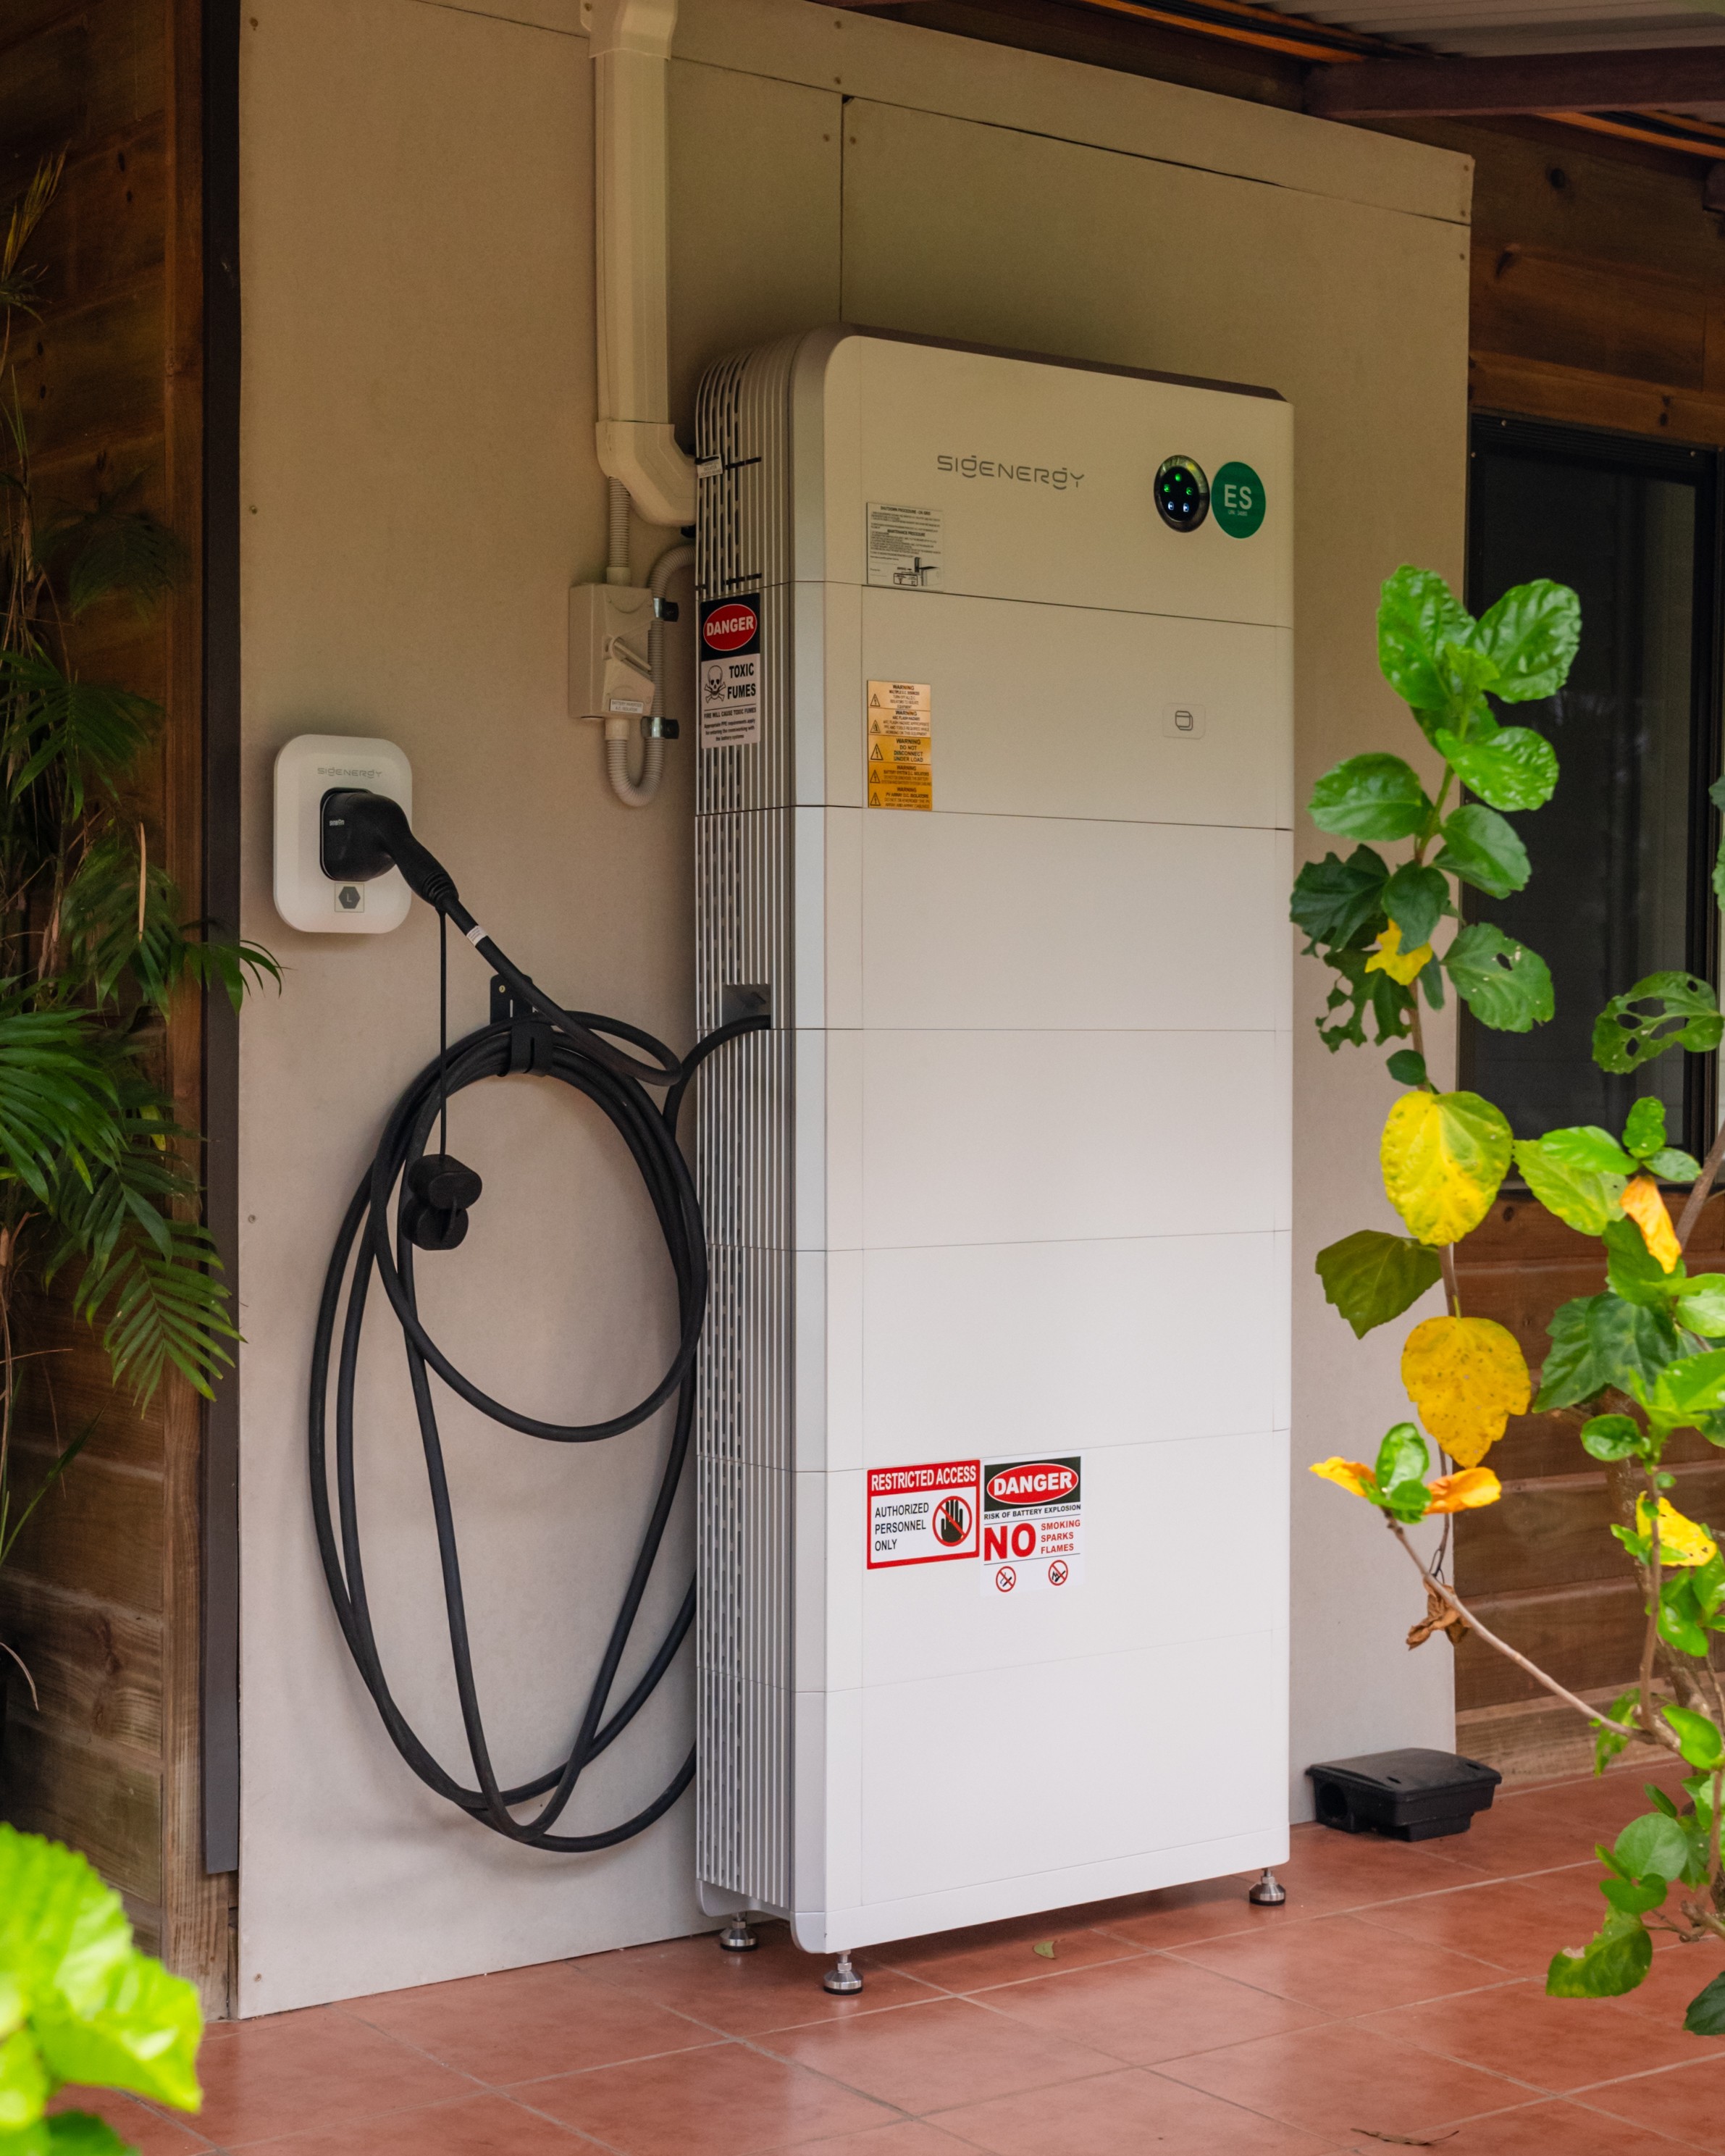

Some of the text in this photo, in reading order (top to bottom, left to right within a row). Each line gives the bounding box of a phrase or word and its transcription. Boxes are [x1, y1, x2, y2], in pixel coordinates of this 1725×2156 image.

[937, 455, 1085, 490] SIGENERGY
[1224, 484, 1252, 510] ES
[706, 616, 754, 637] DANGER
[729, 663, 755, 679] TOXIC
[727, 683, 756, 700] FUMES
[316, 767, 383, 779] SIGENERGY
[346, 894, 352, 902] L
[871, 1465, 976, 1491] RESTRICTED ACCESS
[994, 1472, 1073, 1497] DANGER
[875, 1502, 929, 1519] AUTHORIZED
[1012, 1508, 1042, 1518] BATTERY
[1044, 1504, 1081, 1514] EXPLOSION
[875, 1519, 926, 1535] PERSONNEL
[1041, 1519, 1081, 1531] SMOKING
[875, 1539, 897, 1552] ONLY
[983, 1522, 1036, 1561] NO
[1041, 1532, 1074, 1543] SPARKS
[1041, 1543, 1074, 1554] FLAMES
